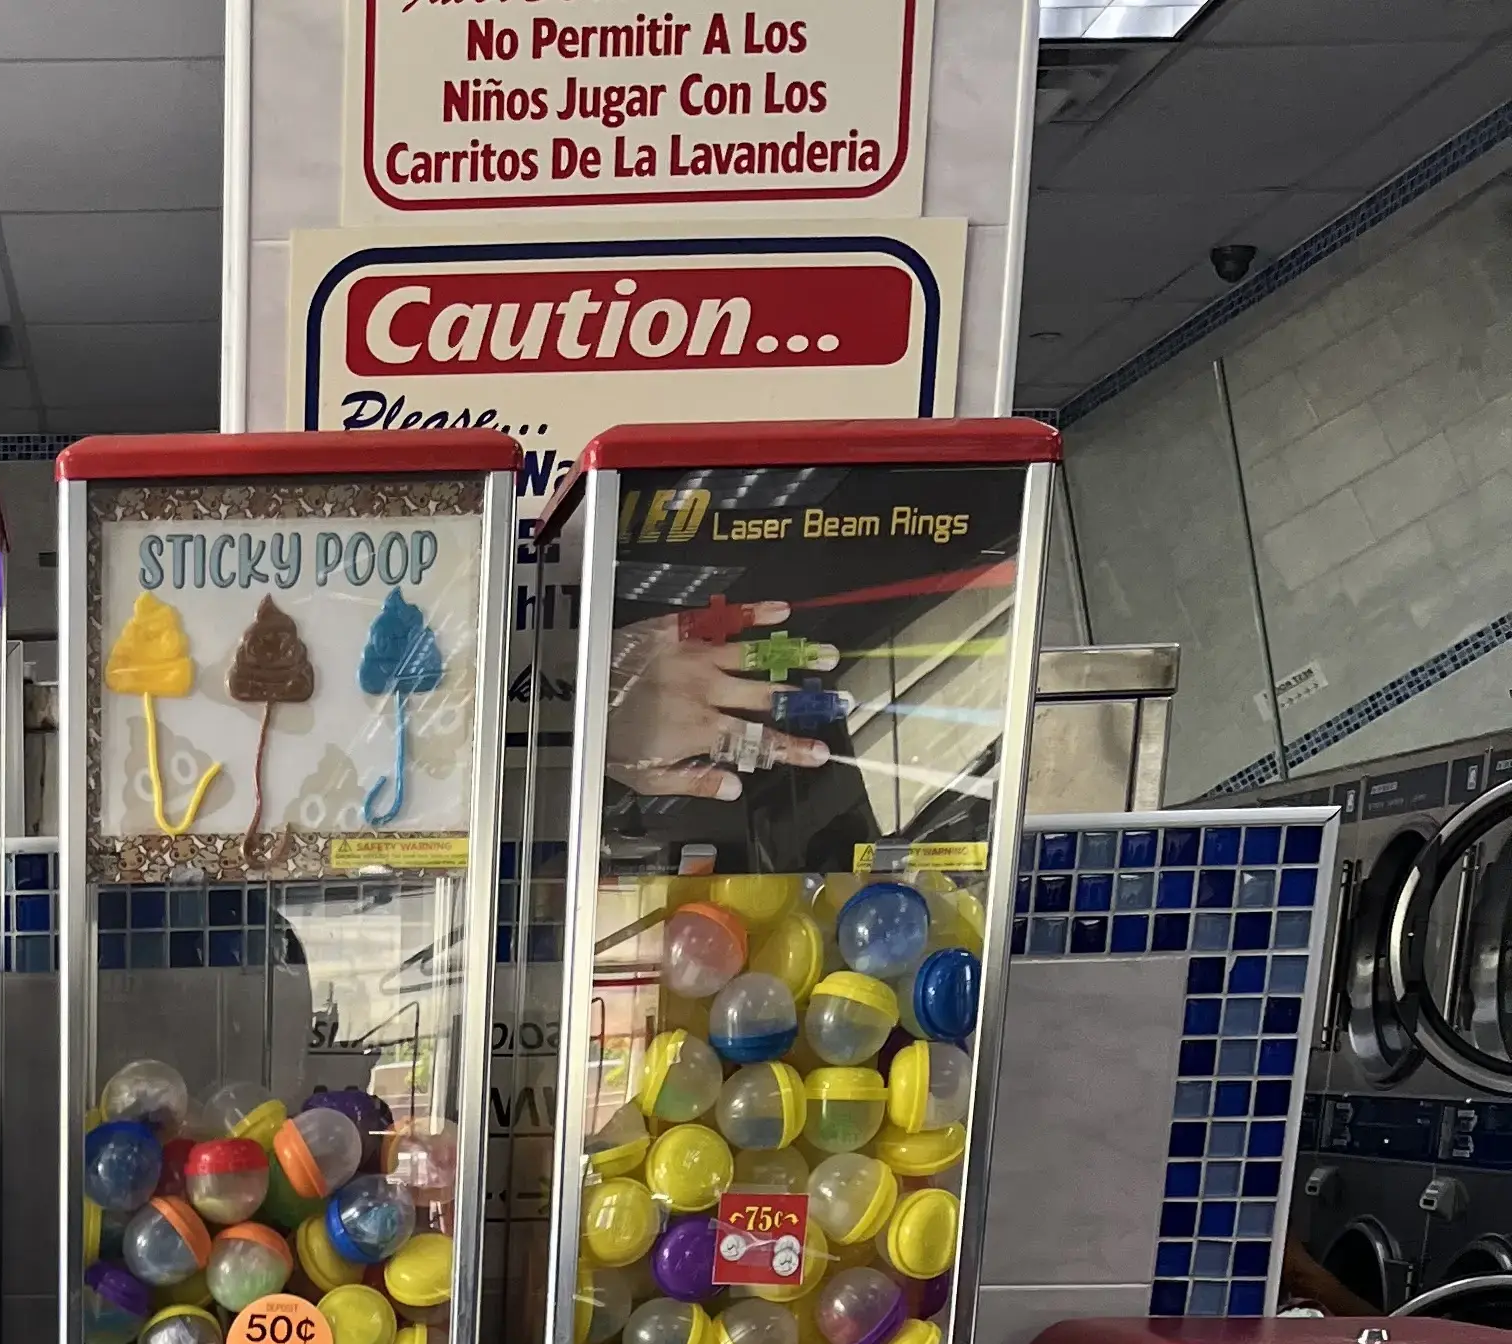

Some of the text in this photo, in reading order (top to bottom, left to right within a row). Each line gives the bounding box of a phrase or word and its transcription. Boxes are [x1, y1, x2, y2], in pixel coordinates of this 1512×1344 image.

[467, 12, 807, 61] No Permitir A Los
[443, 72, 827, 128] Niños Jugar Con Los
[386, 129, 880, 185] Carritos De La Lavanderia
[365, 279, 840, 365] Caution...
[712, 511, 793, 541] Laser
[803, 508, 881, 539] Beam
[890, 506, 970, 543] Rings
[138, 529, 438, 590] STICKY POOP
[356, 841, 453, 851] SAFETY WARNING
[745, 1206, 783, 1232] 75¢
[246, 1314, 316, 1344] 50¢
